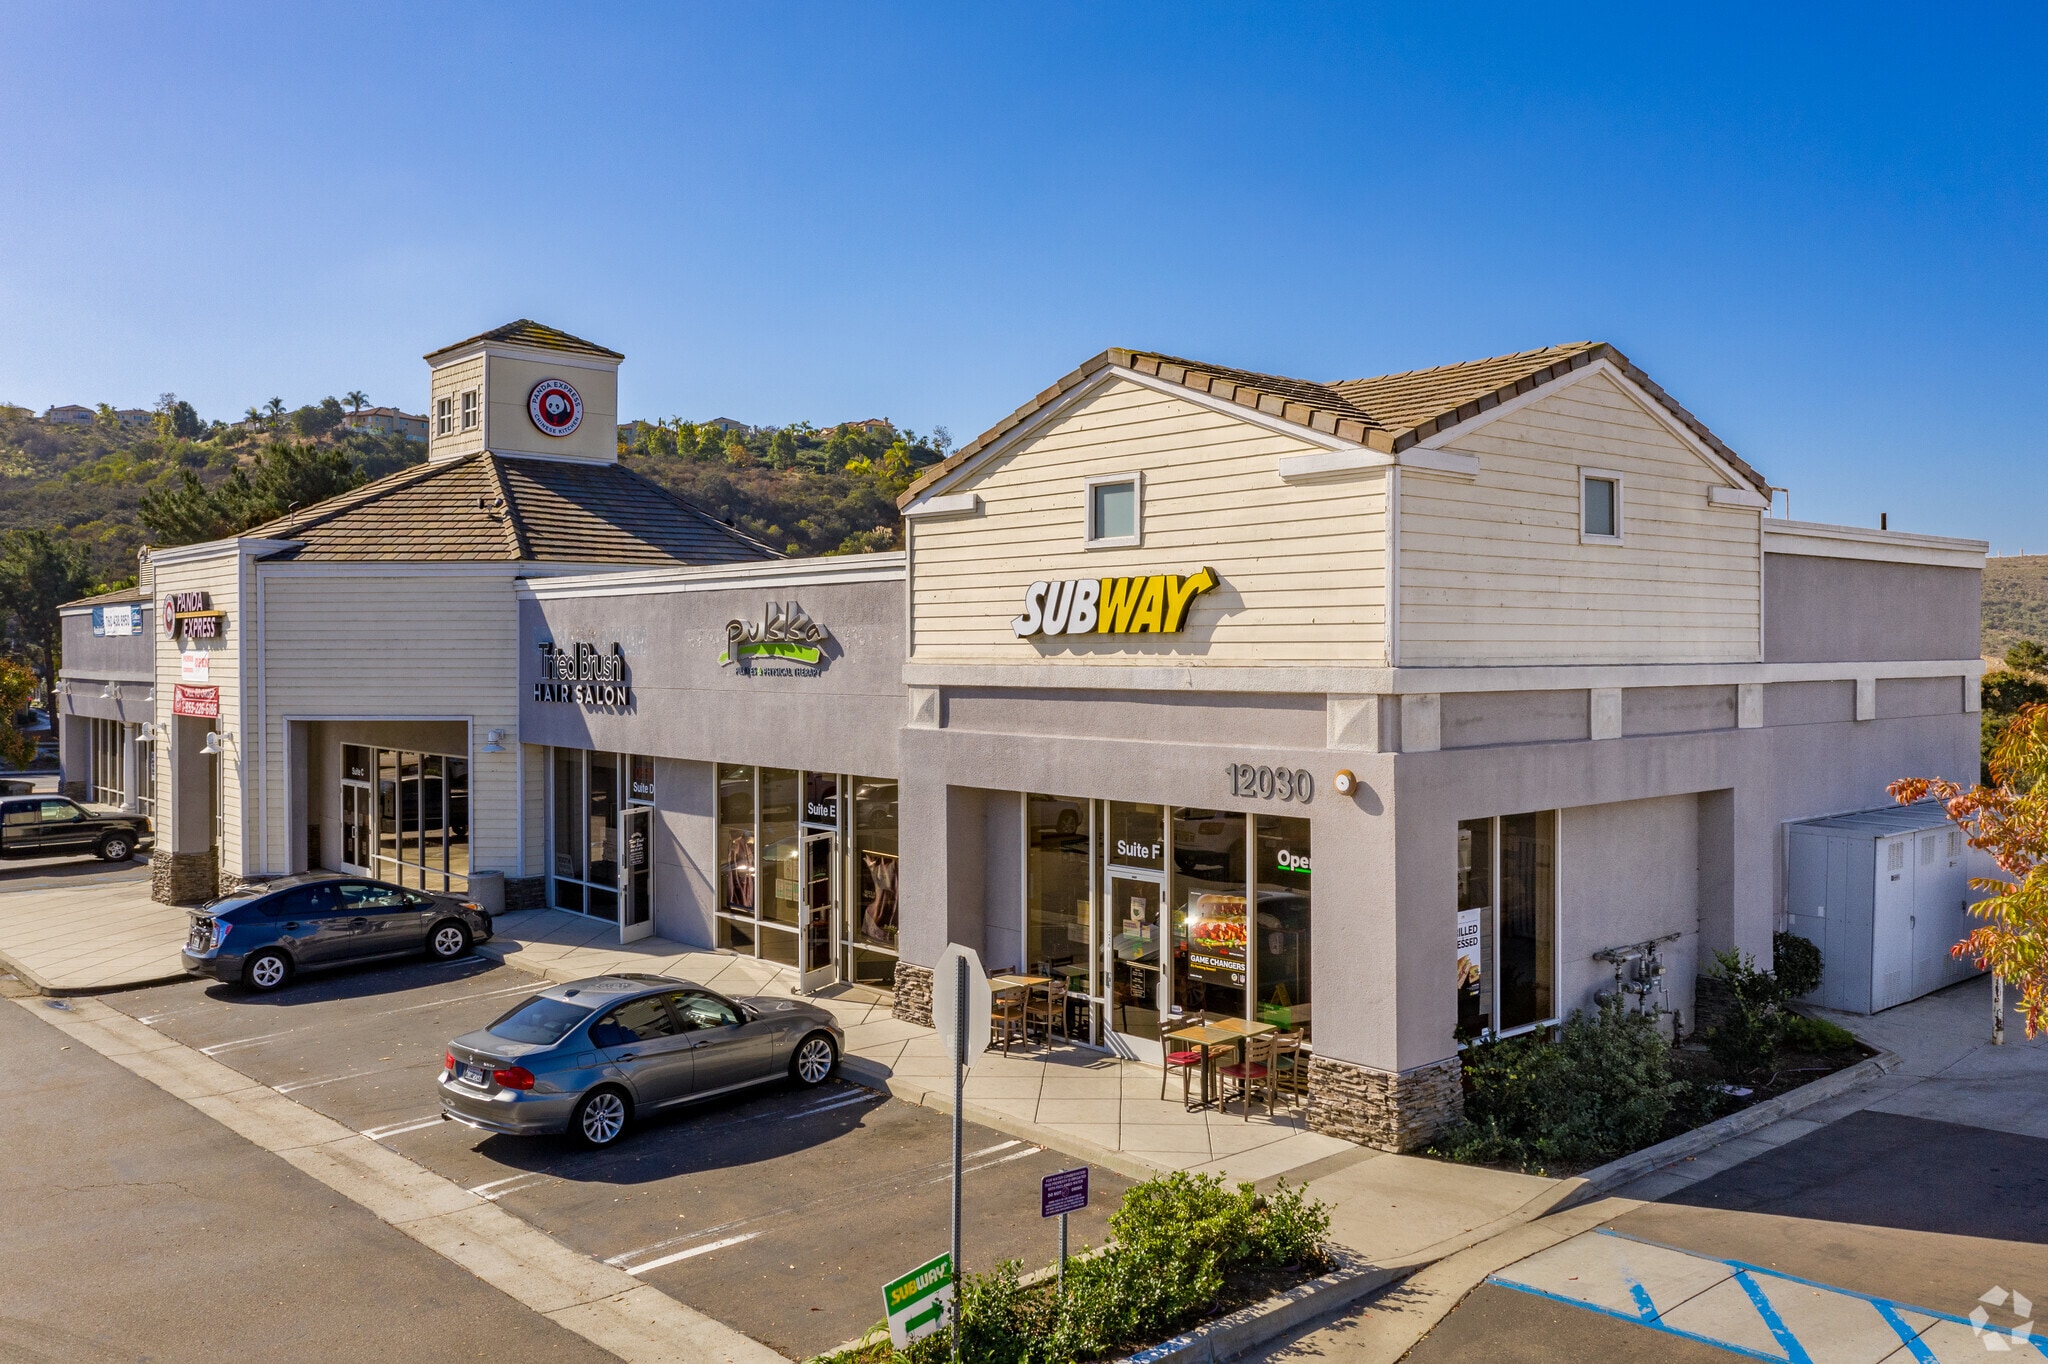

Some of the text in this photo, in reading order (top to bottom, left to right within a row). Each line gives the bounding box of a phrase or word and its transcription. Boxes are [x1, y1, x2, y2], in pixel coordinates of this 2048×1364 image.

[532, 382, 580, 407] PANDA EXPRESS
[534, 414, 579, 434] CHINESE KITCHEN
[177, 591, 204, 612] PANDA
[1010, 566, 1220, 639] SUBWAY
[184, 617, 216, 638] EXPRESS
[725, 601, 825, 661] pukka
[538, 641, 623, 682] Tinted Brush
[764, 668, 793, 678] PHYSICAL
[794, 668, 822, 678] THERAPY
[533, 683, 628, 706] HAIR SALON
[633, 782, 654, 794] Suite D
[1226, 763, 1315, 804] 12030
[808, 802, 836, 818] Suite E
[1117, 839, 1161, 861] Suite F
[1457, 924, 1478, 936] ILLED
[1190, 954, 1210, 965] GAME
[1210, 958, 1246, 972] CHANGERS
[890, 1260, 949, 1306] SUBWAY
